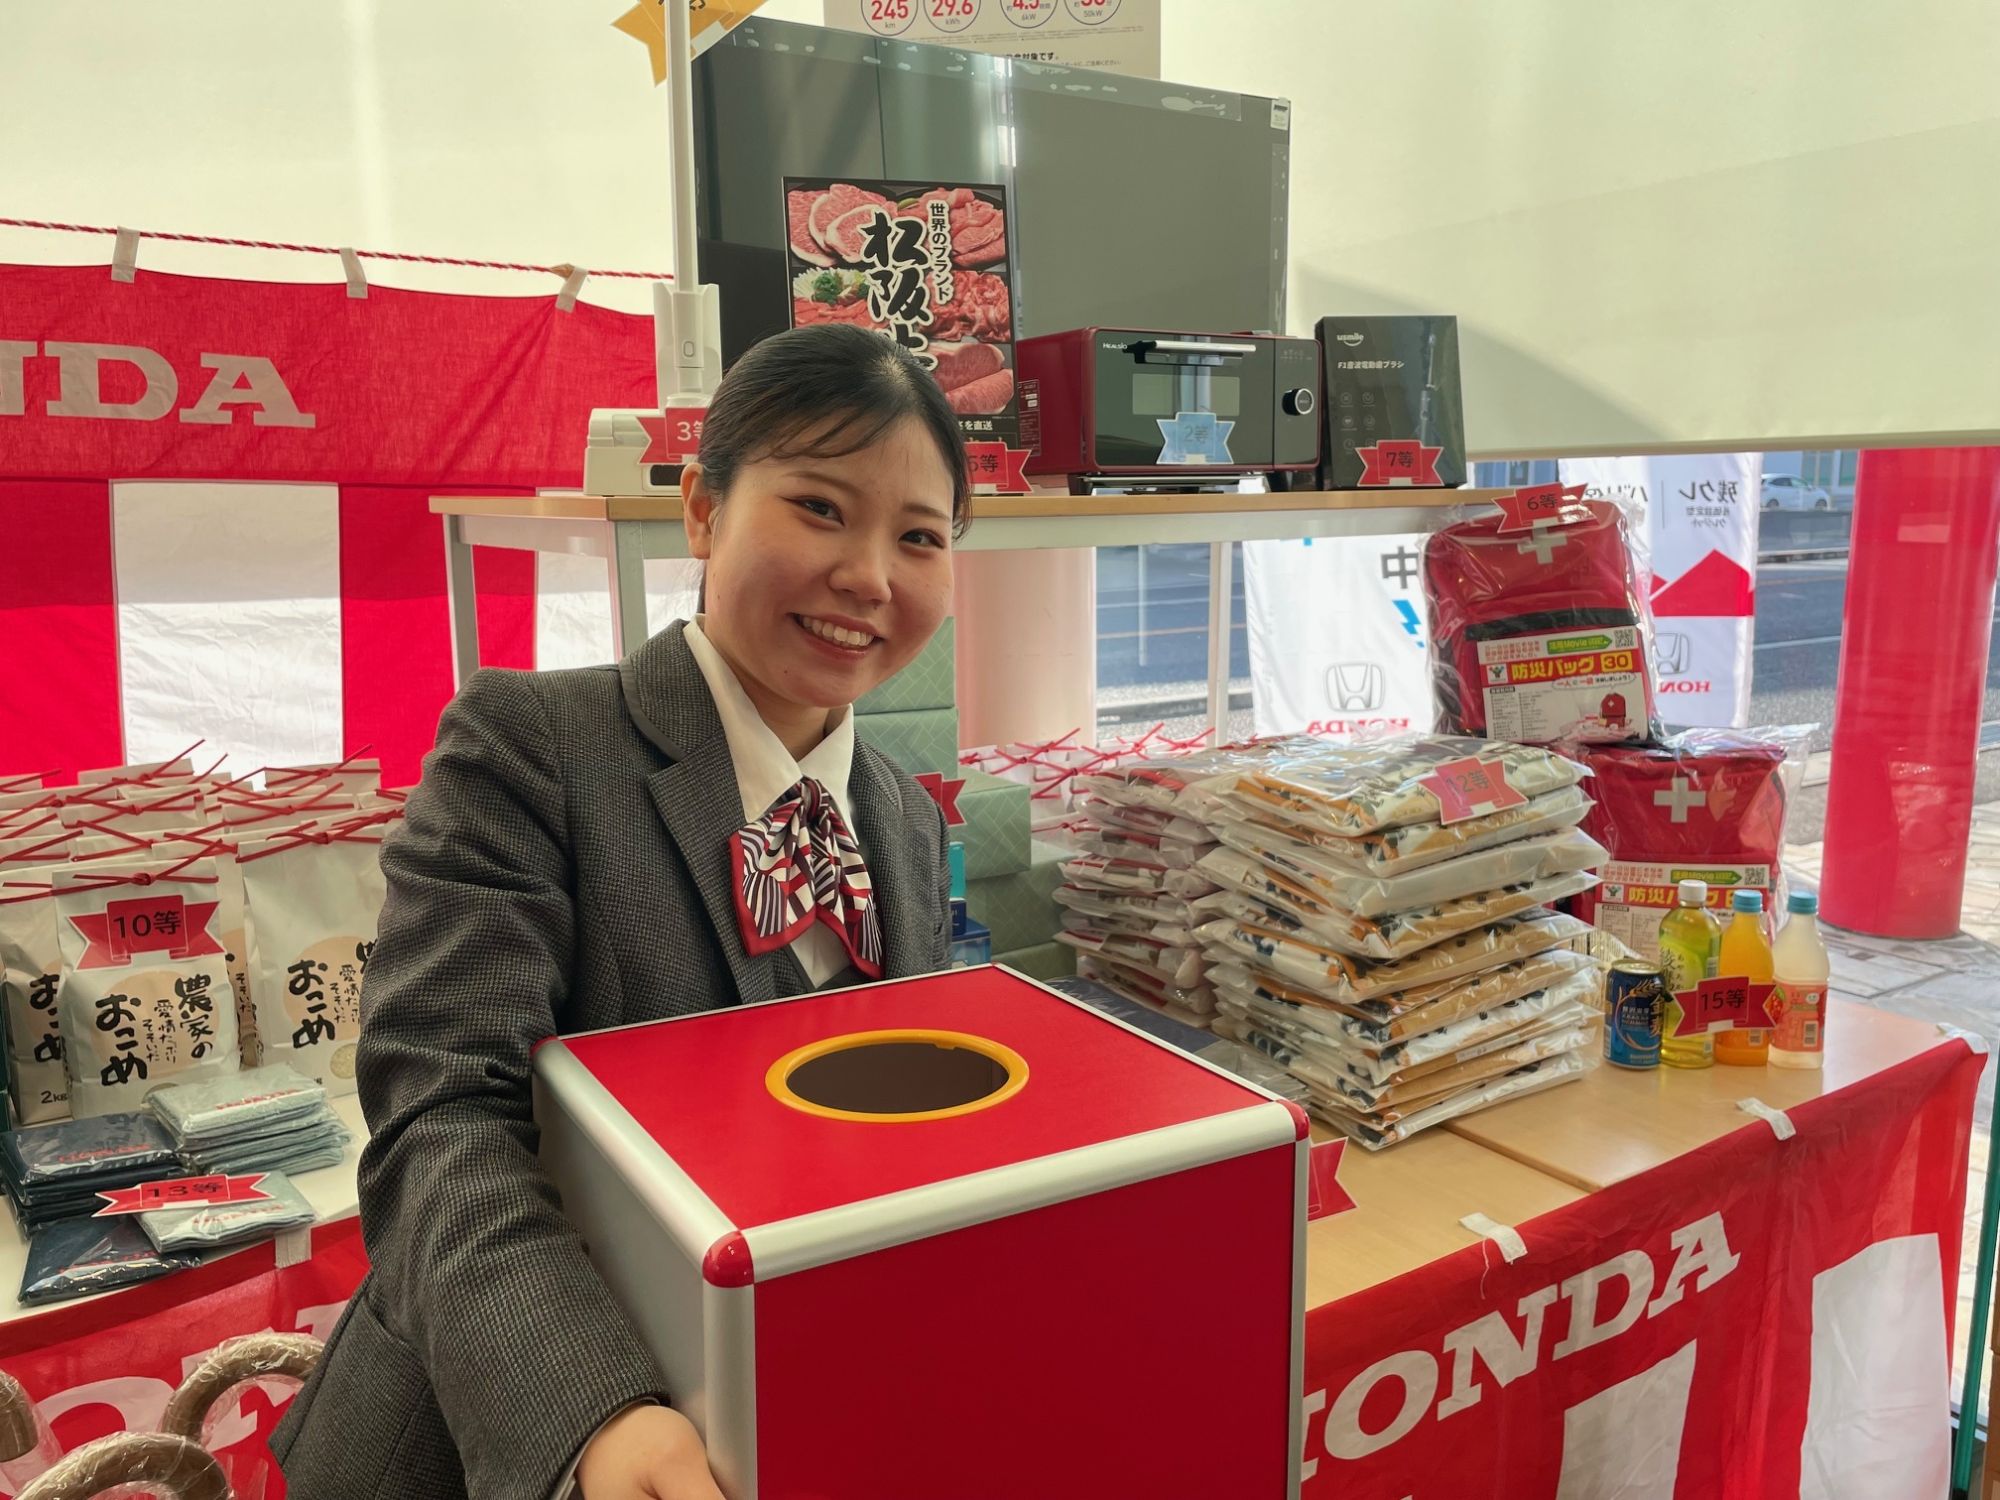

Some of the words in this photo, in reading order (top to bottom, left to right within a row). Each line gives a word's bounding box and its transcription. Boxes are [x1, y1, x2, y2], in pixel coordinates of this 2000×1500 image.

[871, 0, 909, 20] 245
[930, 202, 950, 301] 世界のブランド
[1337, 333, 1364, 341] usmile
[1337, 360, 1405, 370] F1音波電動歯ブラシ
[1184, 424, 1209, 444] 2等
[1386, 451, 1414, 468] 7等
[1527, 494, 1557, 511] 6等
[1511, 656, 1595, 680] 防災バッグ
[1602, 654, 1629, 669] 30
[113, 911, 182, 939] 10等
[287, 959, 336, 1049] おこめ
[1702, 988, 1746, 1011] 15等
[175, 974, 214, 1058] 農家の
[95, 994, 148, 1086] おこめ
[142, 1019, 160, 1063] そそいだ
[147, 1182, 223, 1199] 13等
